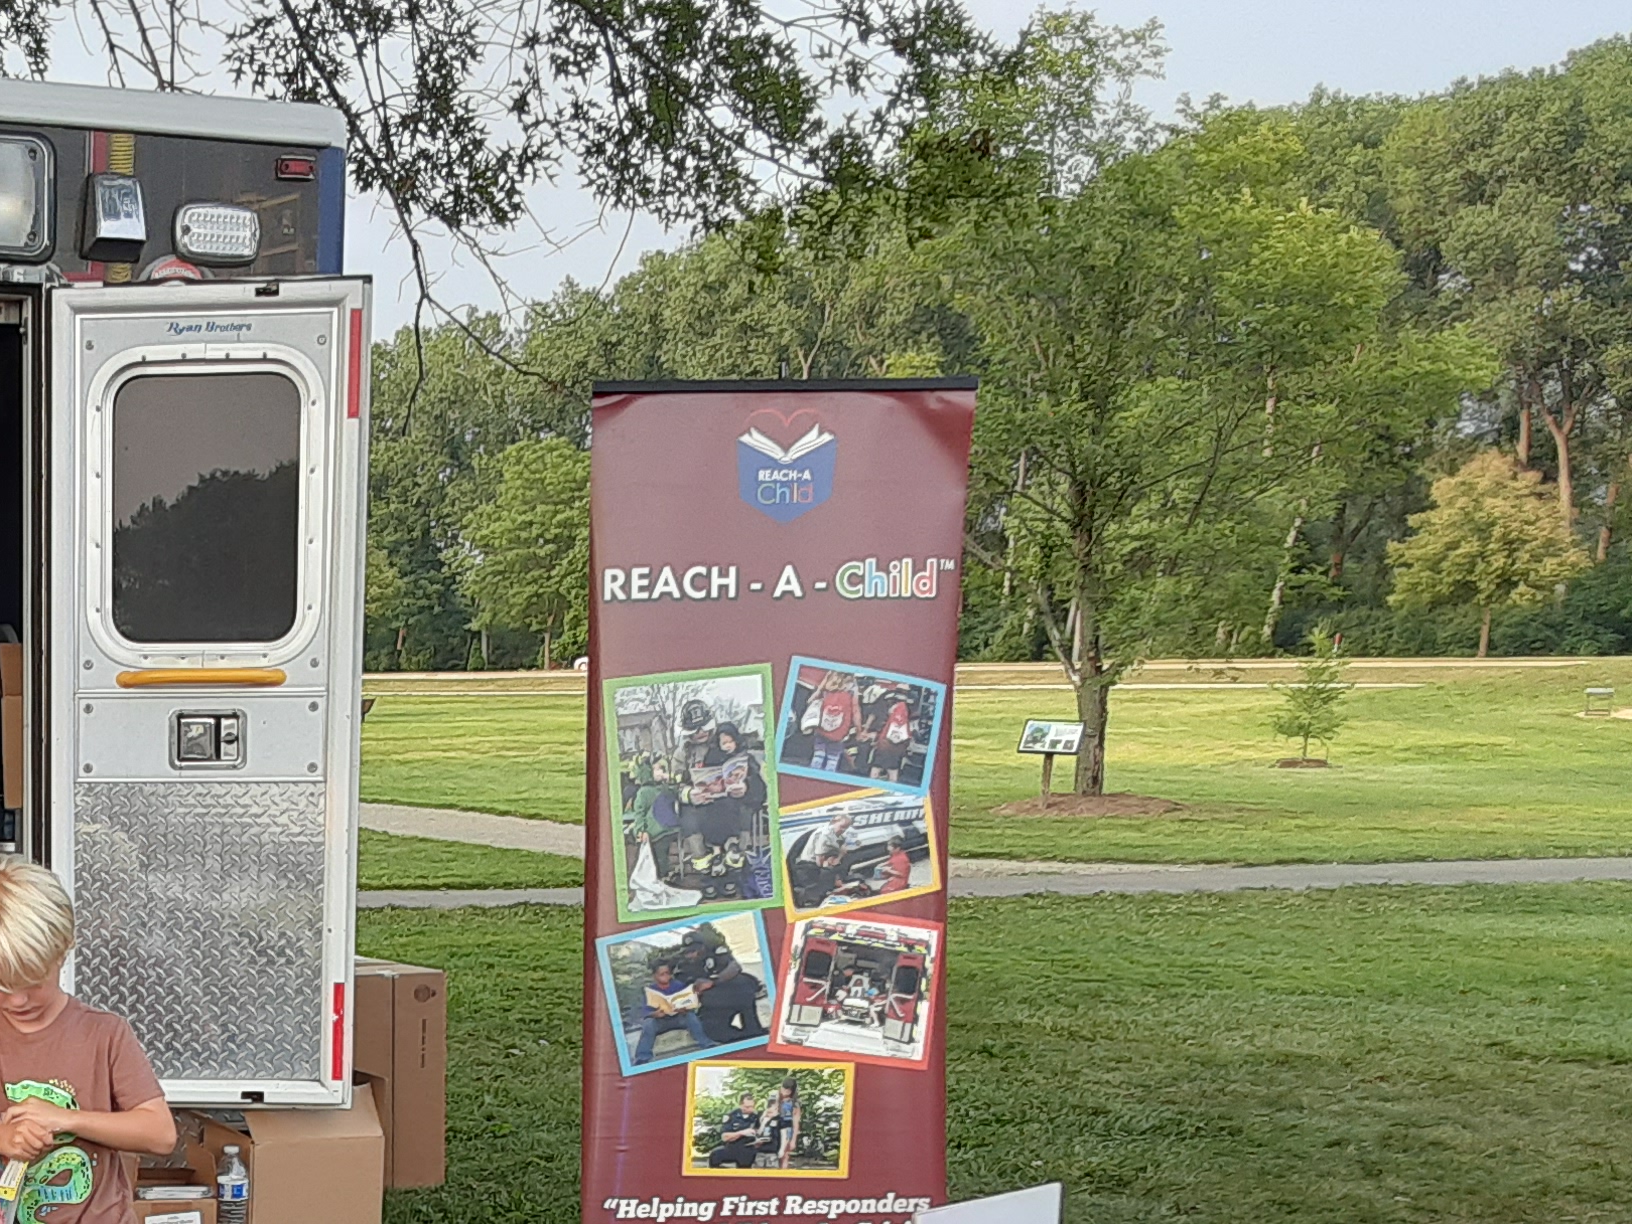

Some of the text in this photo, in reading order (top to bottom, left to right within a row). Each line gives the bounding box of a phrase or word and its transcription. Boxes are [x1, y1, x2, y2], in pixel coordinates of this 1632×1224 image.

[167, 321, 252, 336] Ryan Brothers
[758, 469, 811, 482] REACH-A
[757, 483, 814, 505] Child
[603, 565, 737, 601] REACH
[773, 565, 803, 598] A
[720, 1197, 779, 1217] First
[783, 1193, 931, 1219] Responders
